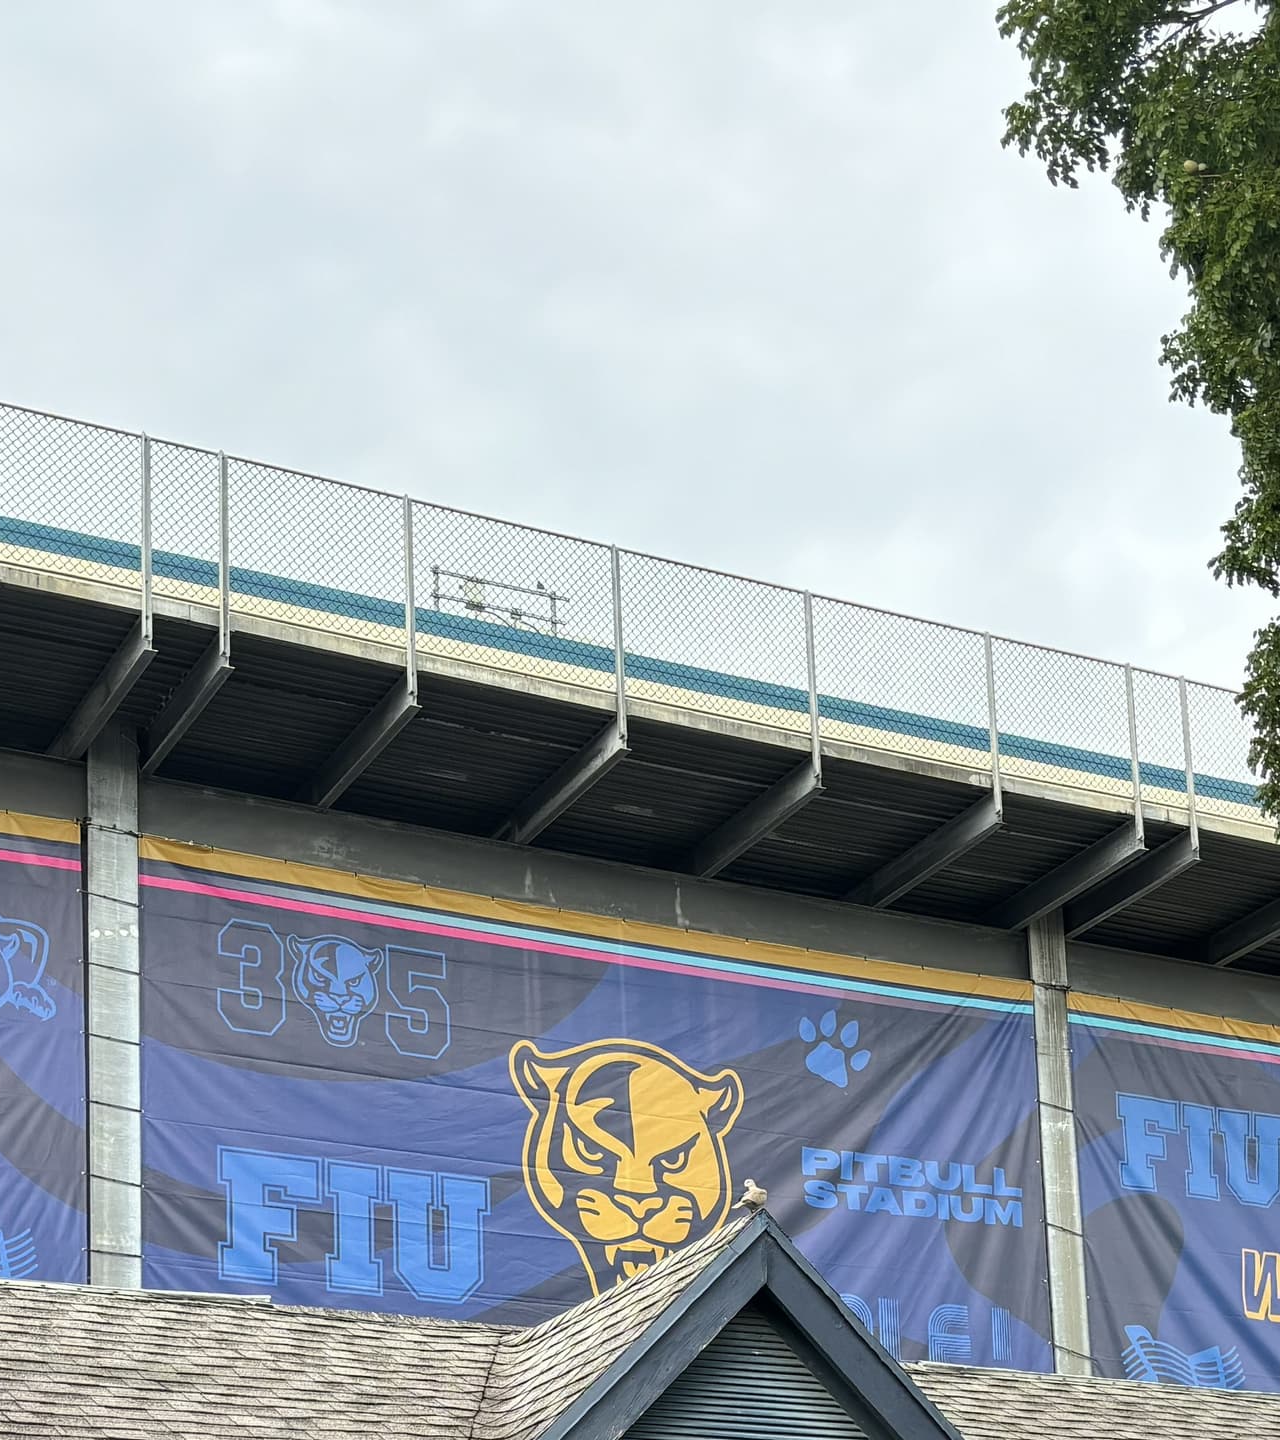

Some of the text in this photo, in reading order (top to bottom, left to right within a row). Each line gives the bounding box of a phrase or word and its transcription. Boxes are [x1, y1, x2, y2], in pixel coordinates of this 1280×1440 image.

[801, 1145, 1023, 1198] PITBULL
[216, 1144, 493, 1305] FIU
[802, 1179, 1024, 1228] STADIUM
